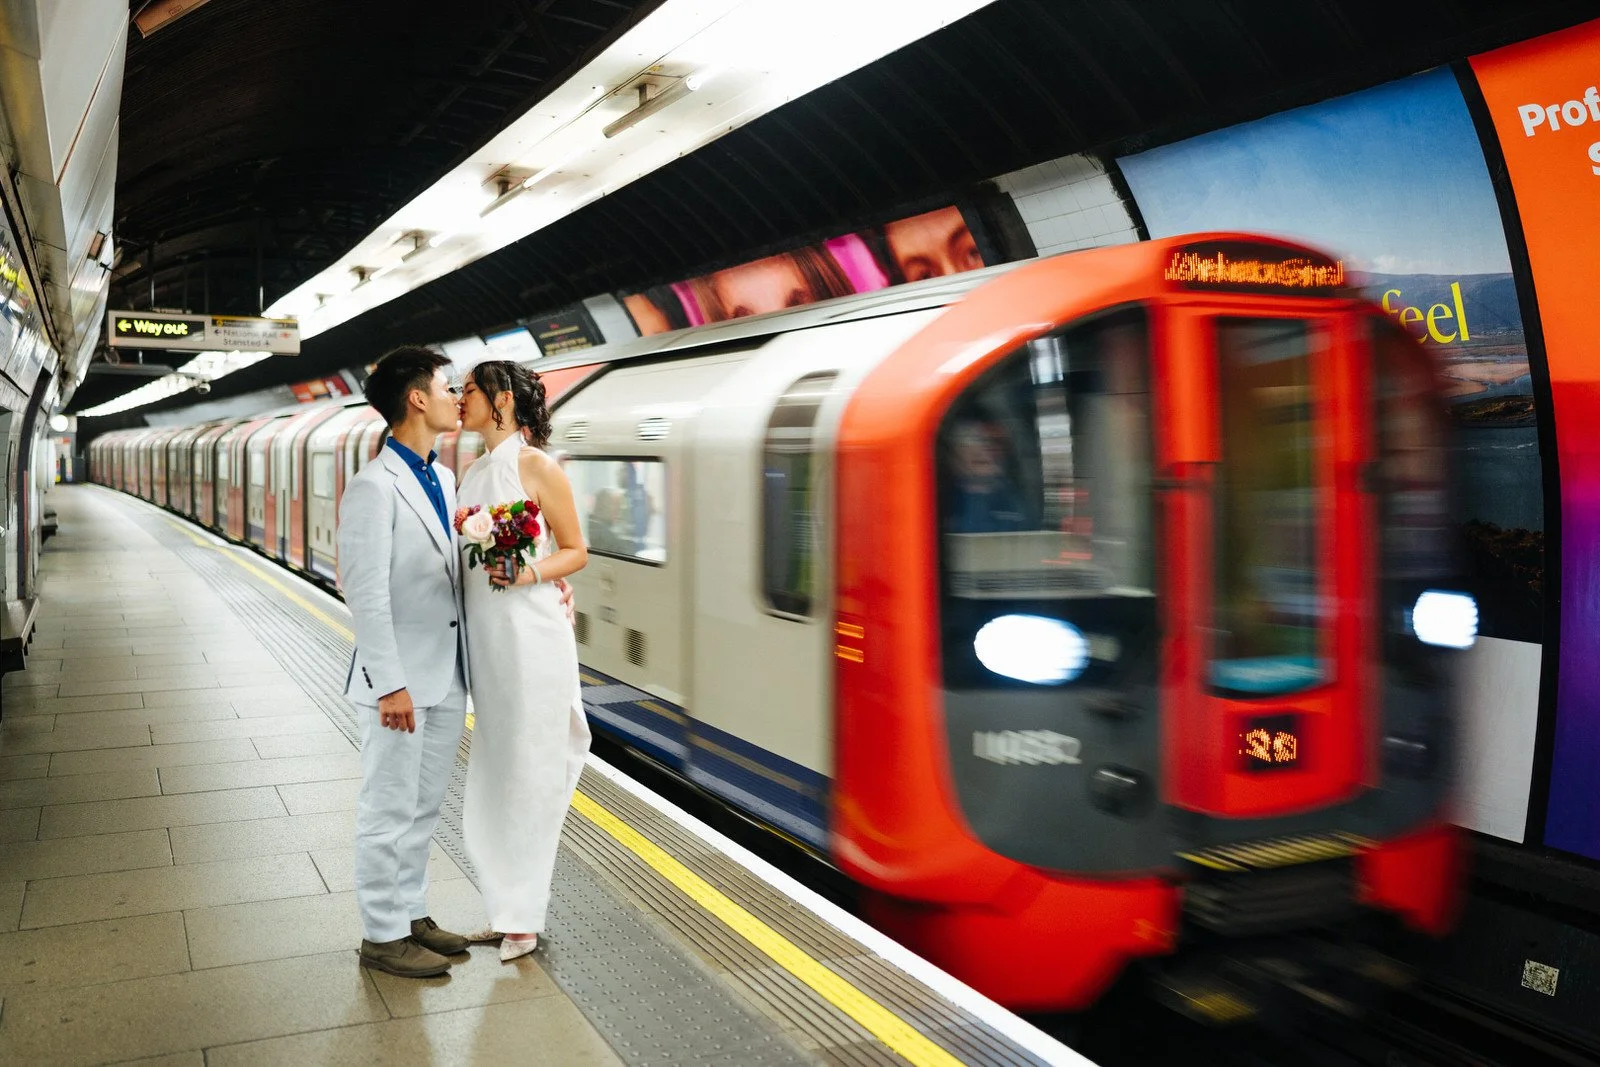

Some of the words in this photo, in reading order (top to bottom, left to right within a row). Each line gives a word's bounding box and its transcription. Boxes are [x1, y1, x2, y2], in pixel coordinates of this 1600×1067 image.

[133, 319, 163, 336] Way
[164, 323, 188, 335] out
[223, 338, 261, 346] Stansted
